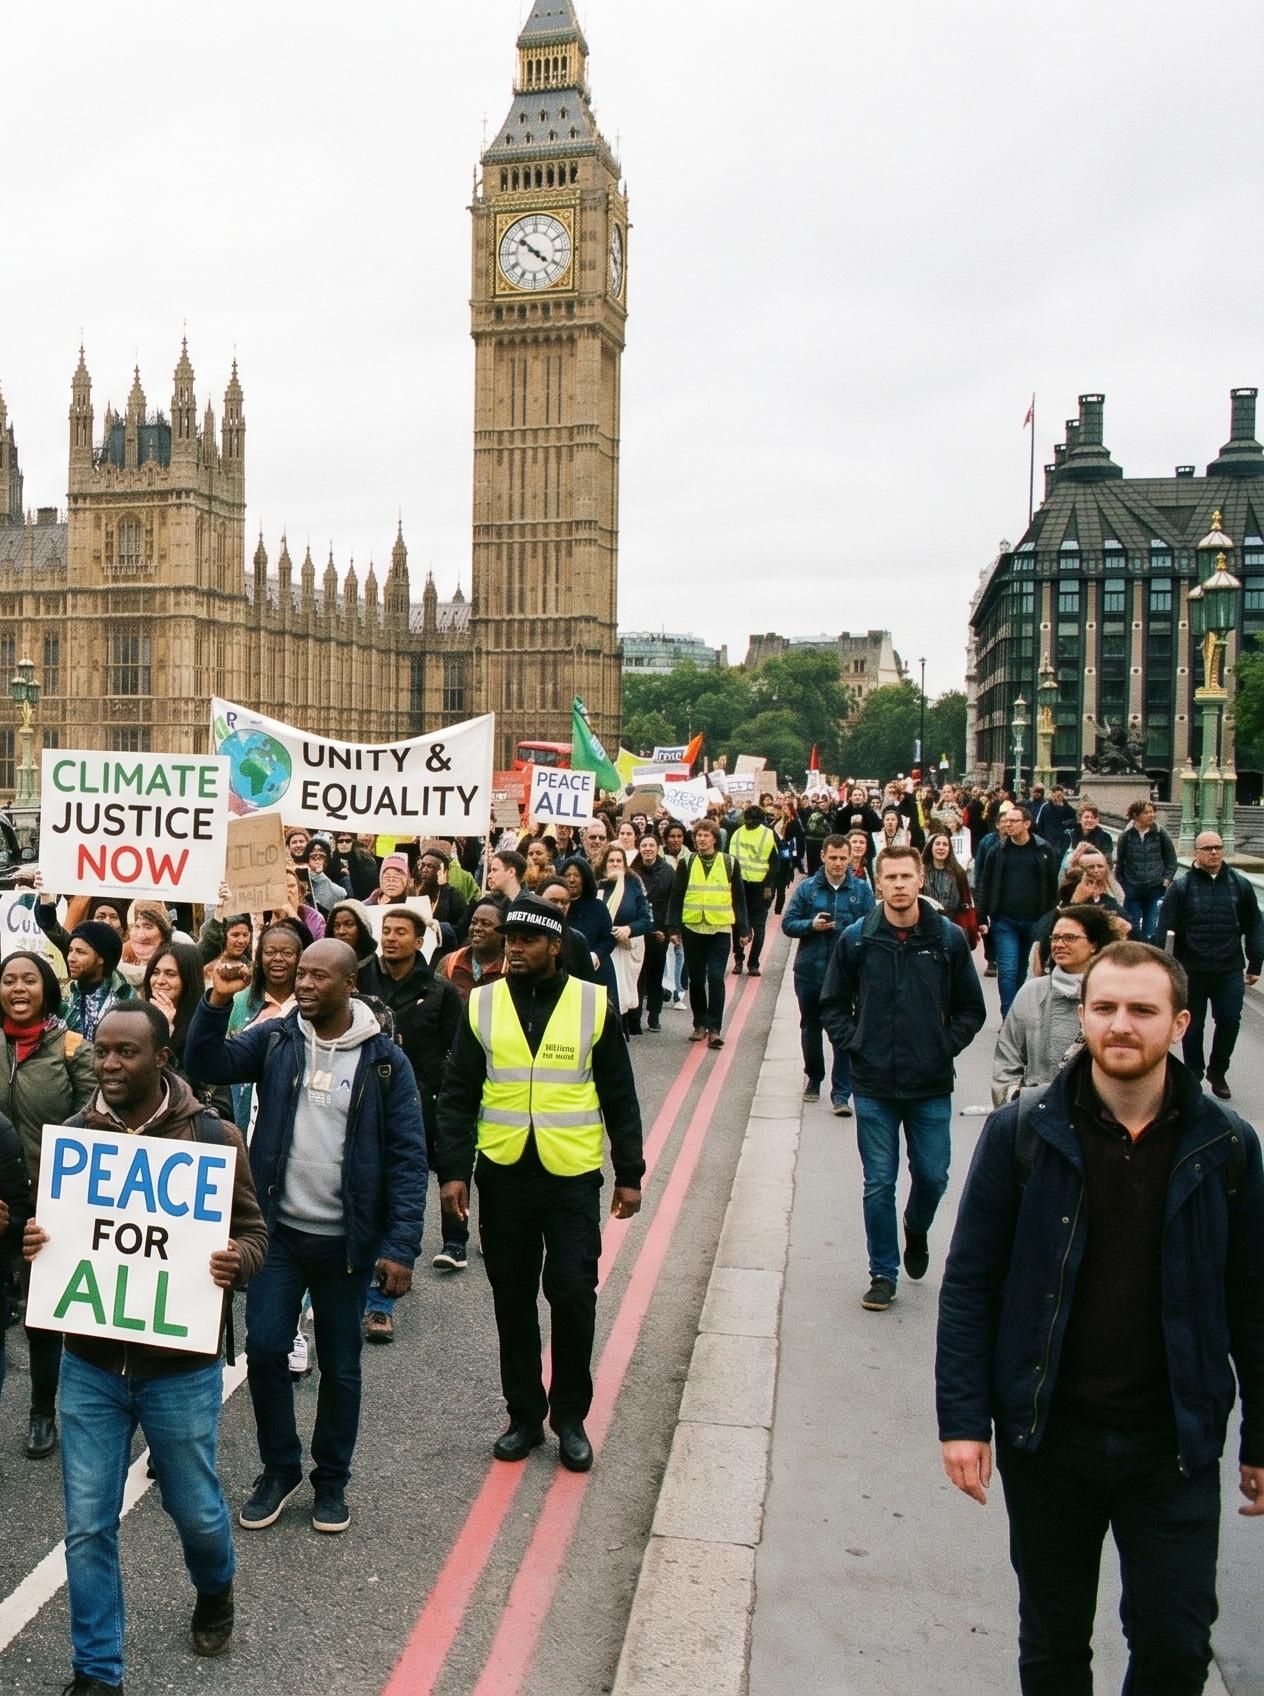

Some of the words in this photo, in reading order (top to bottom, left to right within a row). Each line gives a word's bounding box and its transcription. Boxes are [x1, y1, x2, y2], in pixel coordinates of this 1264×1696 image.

[303, 742, 411, 772] UNITY
[426, 743, 452, 772] &
[52, 759, 219, 798] CLIMATE
[537, 771, 591, 791] PEACE
[301, 780, 479, 820] EQUALITY
[534, 791, 587, 818] ALL
[52, 801, 213, 840] JUSTICE
[77, 844, 189, 885] NOW
[50, 1137, 226, 1222] PEACE
[92, 1219, 168, 1260] FOR
[53, 1259, 188, 1337] ALL
